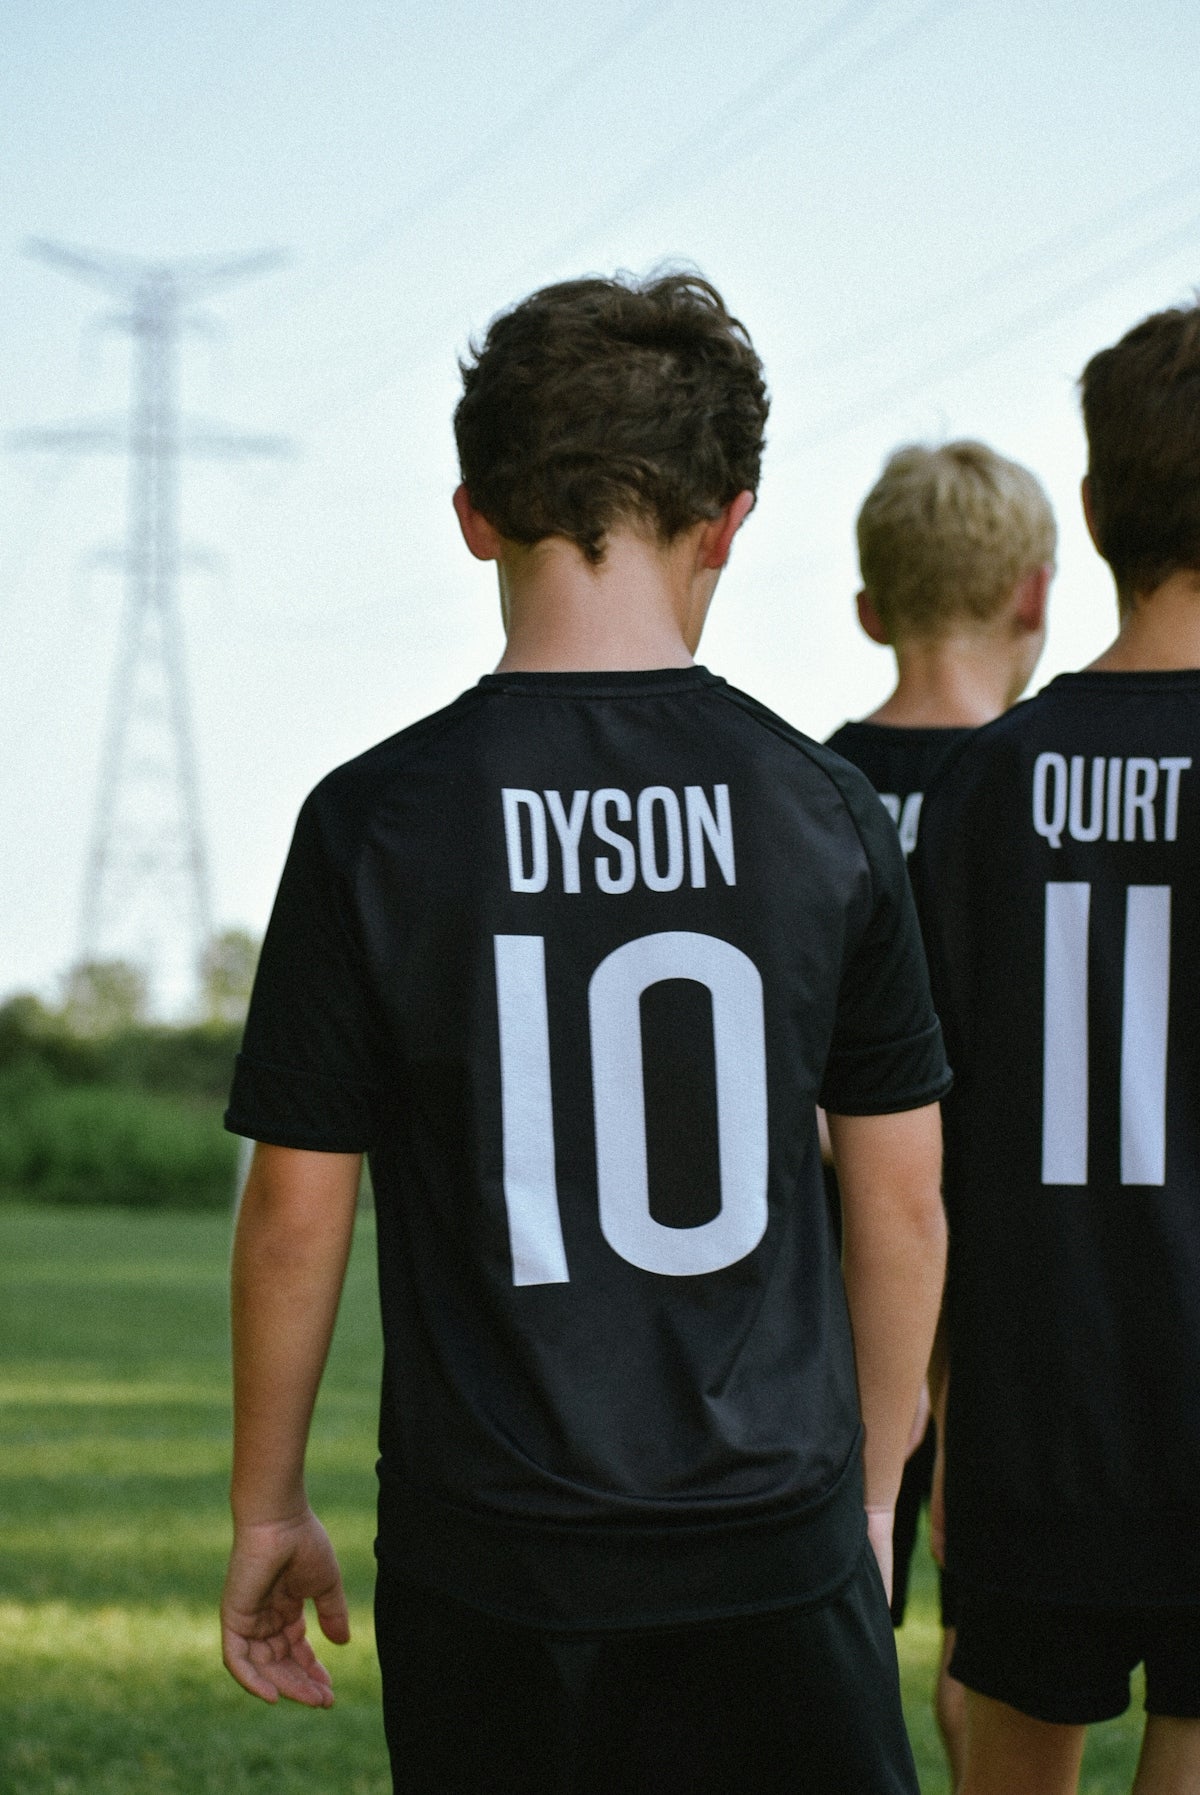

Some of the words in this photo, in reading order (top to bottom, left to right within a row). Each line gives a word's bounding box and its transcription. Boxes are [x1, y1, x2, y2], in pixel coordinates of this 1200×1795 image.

[501, 783, 736, 895] DYSON
[1032, 751, 1193, 849] QUIRT
[493, 931, 769, 1287] 10
[1042, 882, 1171, 1186] 11
